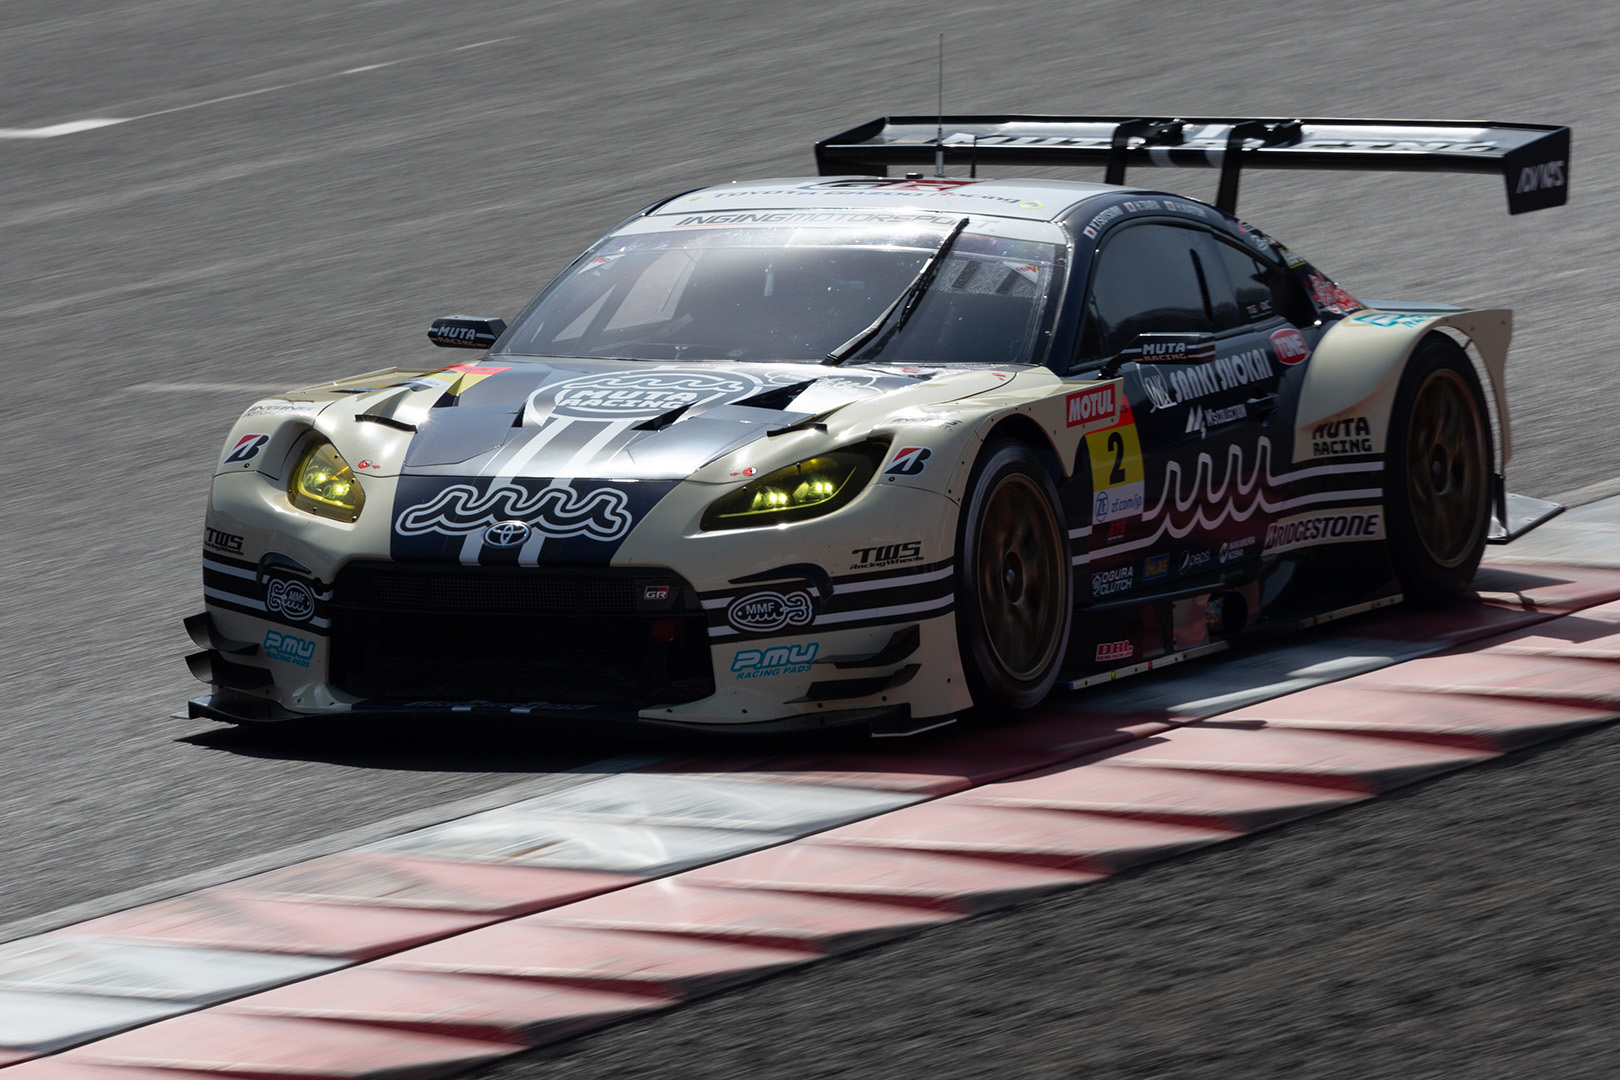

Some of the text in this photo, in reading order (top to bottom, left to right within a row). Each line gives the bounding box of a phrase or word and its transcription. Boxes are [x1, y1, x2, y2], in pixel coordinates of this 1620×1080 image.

[438, 326, 477, 340] MUTA
[1142, 343, 1186, 355] MUTA
[1143, 354, 1188, 362] RACING
[568, 390, 698, 401] MUTA
[1068, 389, 1115, 423] MOTUL
[1313, 417, 1370, 439] MUTA
[1313, 439, 1372, 456] RACING
[1107, 432, 1126, 485] 2
[206, 527, 244, 550] TWS
[1264, 515, 1379, 549] BRIDGESTONE
[852, 541, 922, 563] TWS
[1101, 566, 1134, 583] OGURA
[645, 590, 667, 599] GR
[1100, 577, 1133, 595] CLUTCH
[745, 602, 775, 615] MMF
[292, 657, 311, 668] PADS
[736, 664, 814, 680] RACING PADS
